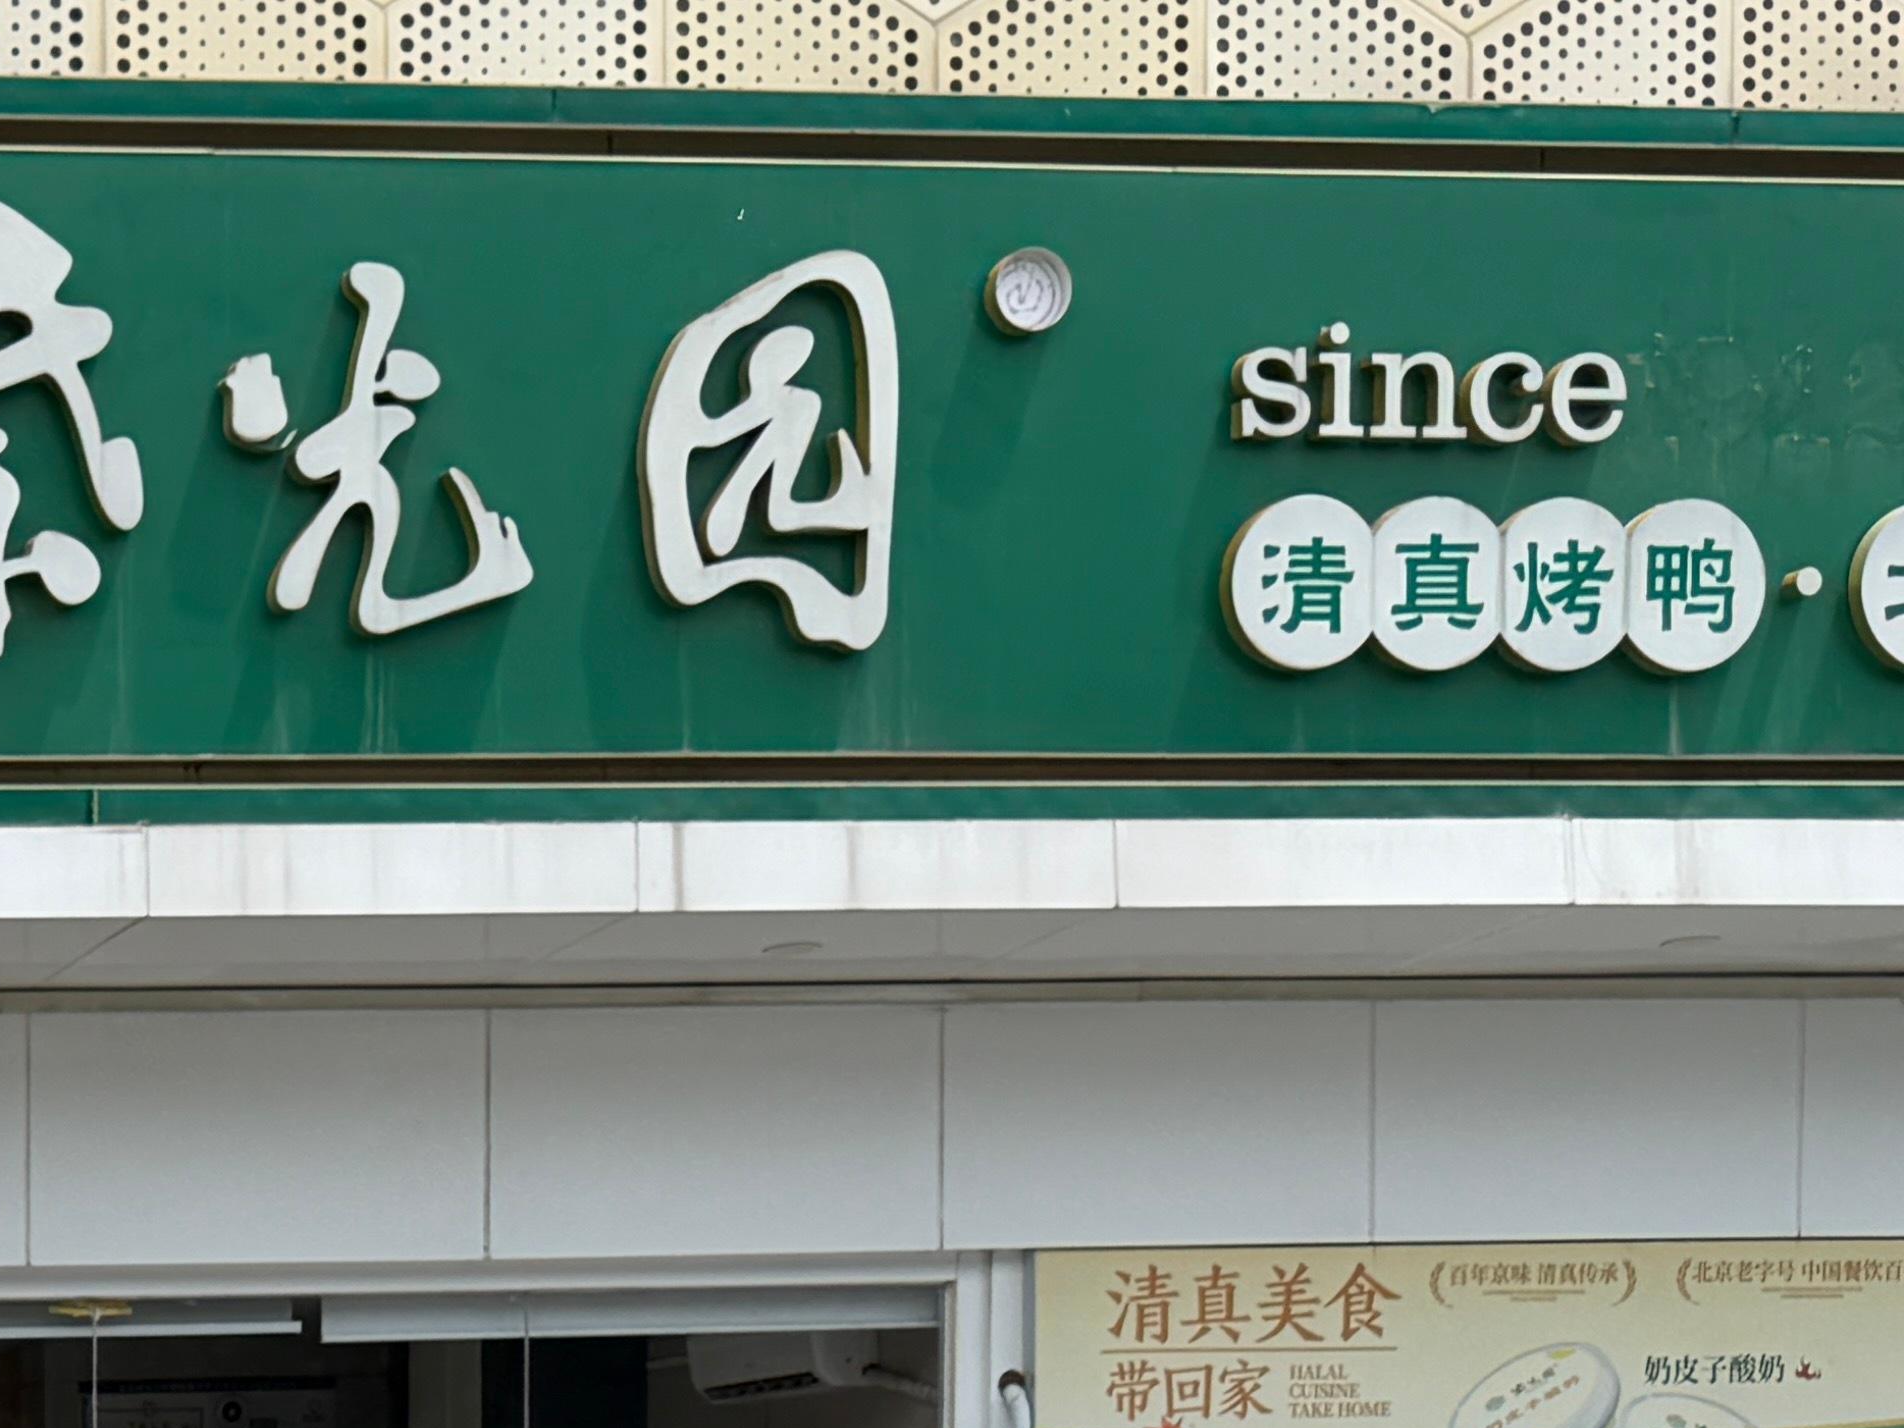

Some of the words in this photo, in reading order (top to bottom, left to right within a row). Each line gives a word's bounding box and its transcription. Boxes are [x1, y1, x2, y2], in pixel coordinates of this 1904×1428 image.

[1236, 321, 1626, 443] since
[1105, 1262, 1402, 1345] 清真美食
[1290, 1364, 1348, 1381] HALAL
[1644, 1353, 1785, 1385] 奶皮子酸奶
[1105, 1358, 1273, 1422] 带回家
[1289, 1383, 1361, 1399] CUISINE
[1289, 1402, 1336, 1418] TAKE
[1338, 1402, 1391, 1418] HOME
